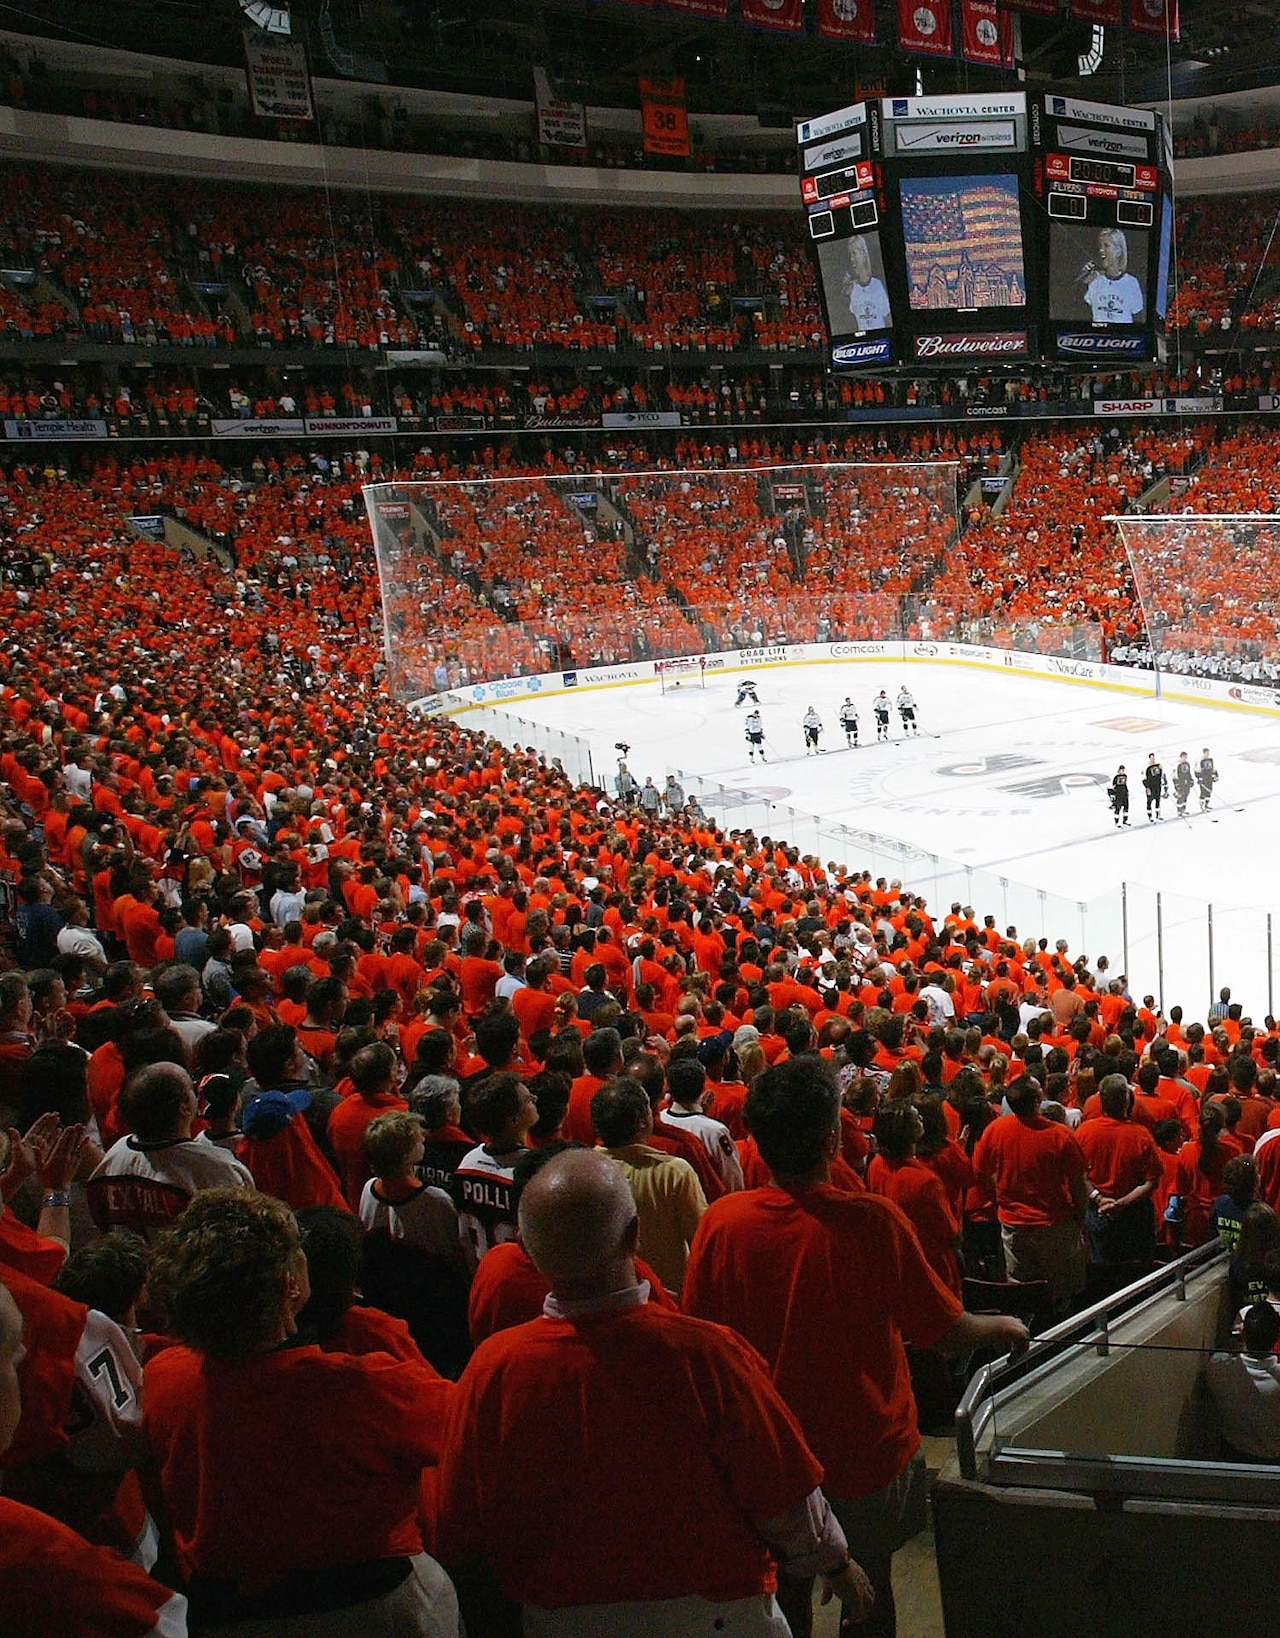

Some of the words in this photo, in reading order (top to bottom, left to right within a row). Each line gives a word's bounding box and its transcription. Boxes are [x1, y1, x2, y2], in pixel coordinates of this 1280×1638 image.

[916, 107, 978, 116] WACHOVIA
[981, 105, 1015, 113] CENTER
[654, 110, 676, 131] 38
[1032, 103, 1041, 146] comcast
[870, 109, 880, 152] comcast
[936, 132, 981, 144] verizon
[1088, 137, 1123, 152] verizon
[1047, 168, 1069, 177] TOYOTA
[1053, 181, 1082, 192] FLYERS
[1095, 187, 1118, 197] TOYOTA
[917, 333, 1024, 356] Budweiser
[1062, 336, 1094, 349] BUD
[1097, 337, 1141, 349] LIGHT
[836, 347, 857, 359] BUD
[858, 343, 887, 357] LIGHT
[966, 404, 1009, 416] comcast
[1102, 401, 1154, 412] SHARP
[524, 414, 600, 428] Budweiser
[637, 413, 660, 421] PECO
[33, 421, 66, 432] Temple
[67, 421, 96, 432] Health
[244, 425, 280, 434] verizon
[739, 649, 765, 658] GRAB
[768, 647, 788, 656] LIFE
[832, 644, 885, 656] comcast
[1055, 659, 1094, 678] NovaCare
[583, 671, 639, 683] WACHOVIA
[488, 680, 523, 692] Choose
[1192, 679, 1212, 690] PECO
[883, 802, 1032, 817] CENTER
[463, 1180, 511, 1211] POLLI
[87, 1347, 130, 1410] 7
